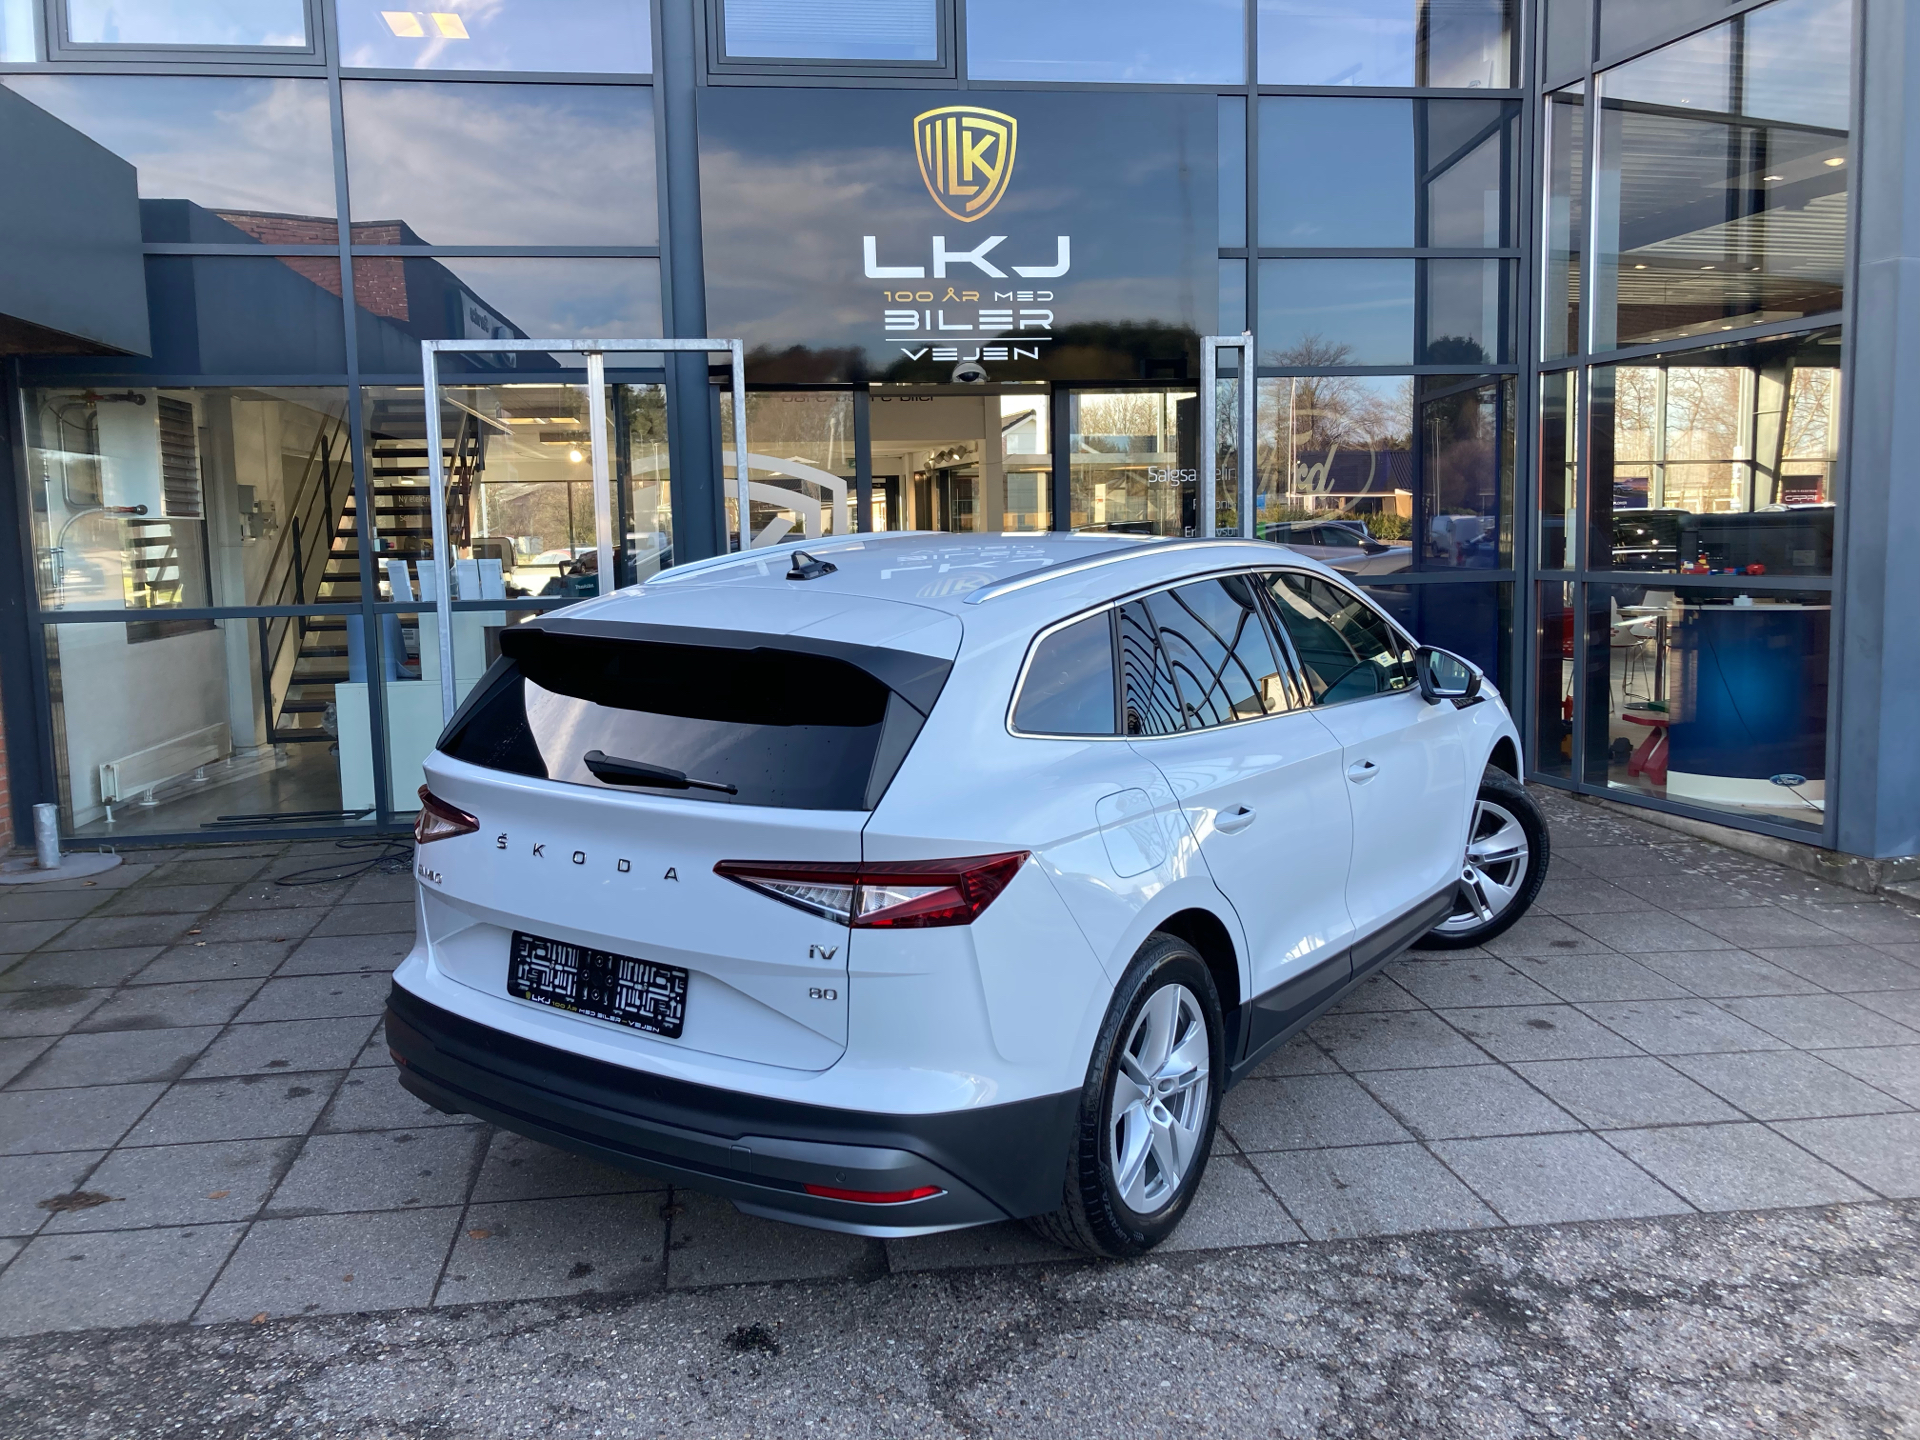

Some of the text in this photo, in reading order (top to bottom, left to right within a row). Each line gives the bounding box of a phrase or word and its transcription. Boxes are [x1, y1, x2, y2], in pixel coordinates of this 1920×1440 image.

[864, 235, 1070, 278] LKJ
[884, 287, 1053, 302] 100 ÅR MED
[884, 309, 1054, 330] BILER
[901, 347, 1039, 361] VEJEN
[497, 832, 679, 882] ŠKODA
[531, 994, 551, 1005] LKJ
[809, 987, 838, 1001] 80
